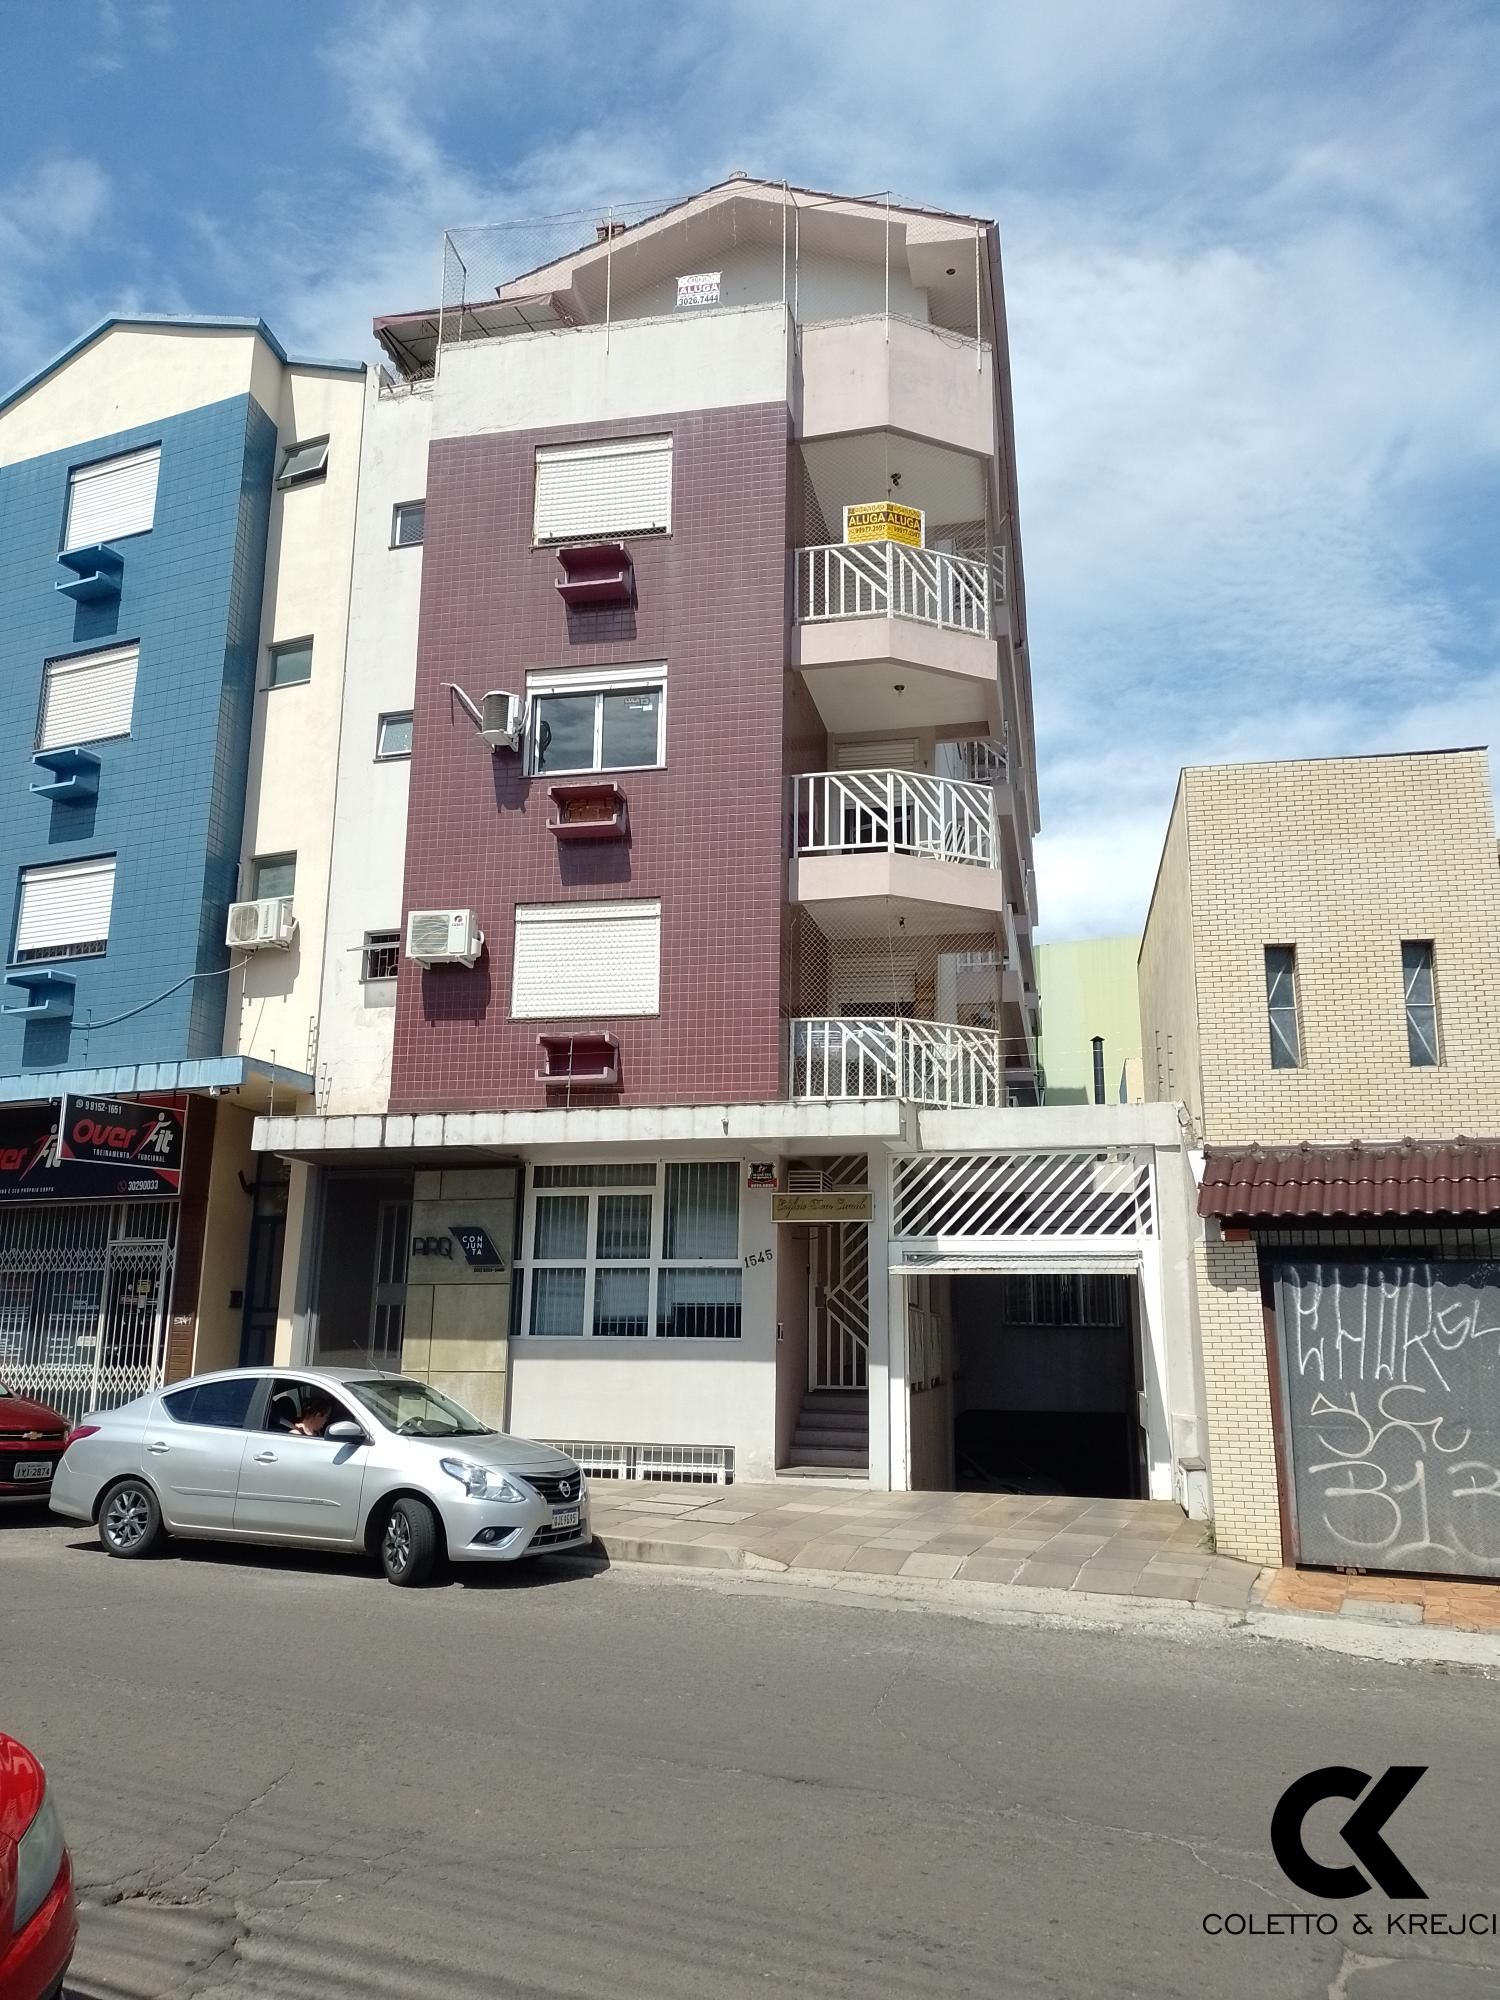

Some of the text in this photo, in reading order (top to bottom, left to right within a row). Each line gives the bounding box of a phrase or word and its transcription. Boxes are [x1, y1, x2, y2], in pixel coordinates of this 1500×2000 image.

[680, 283, 719, 295] ALUGA
[679, 295, 719, 305] 3026.7444
[849, 512, 886, 527] ALUGA
[887, 512, 921, 531] ALUGA
[72, 1118, 137, 1149] Over
[127, 1180, 159, 1191] 30290033
[462, 1235, 483, 1243] CON
[412, 1236, 453, 1260] ARQ
[471, 1248, 482, 1256] TA
[743, 1248, 774, 1269] 1545
